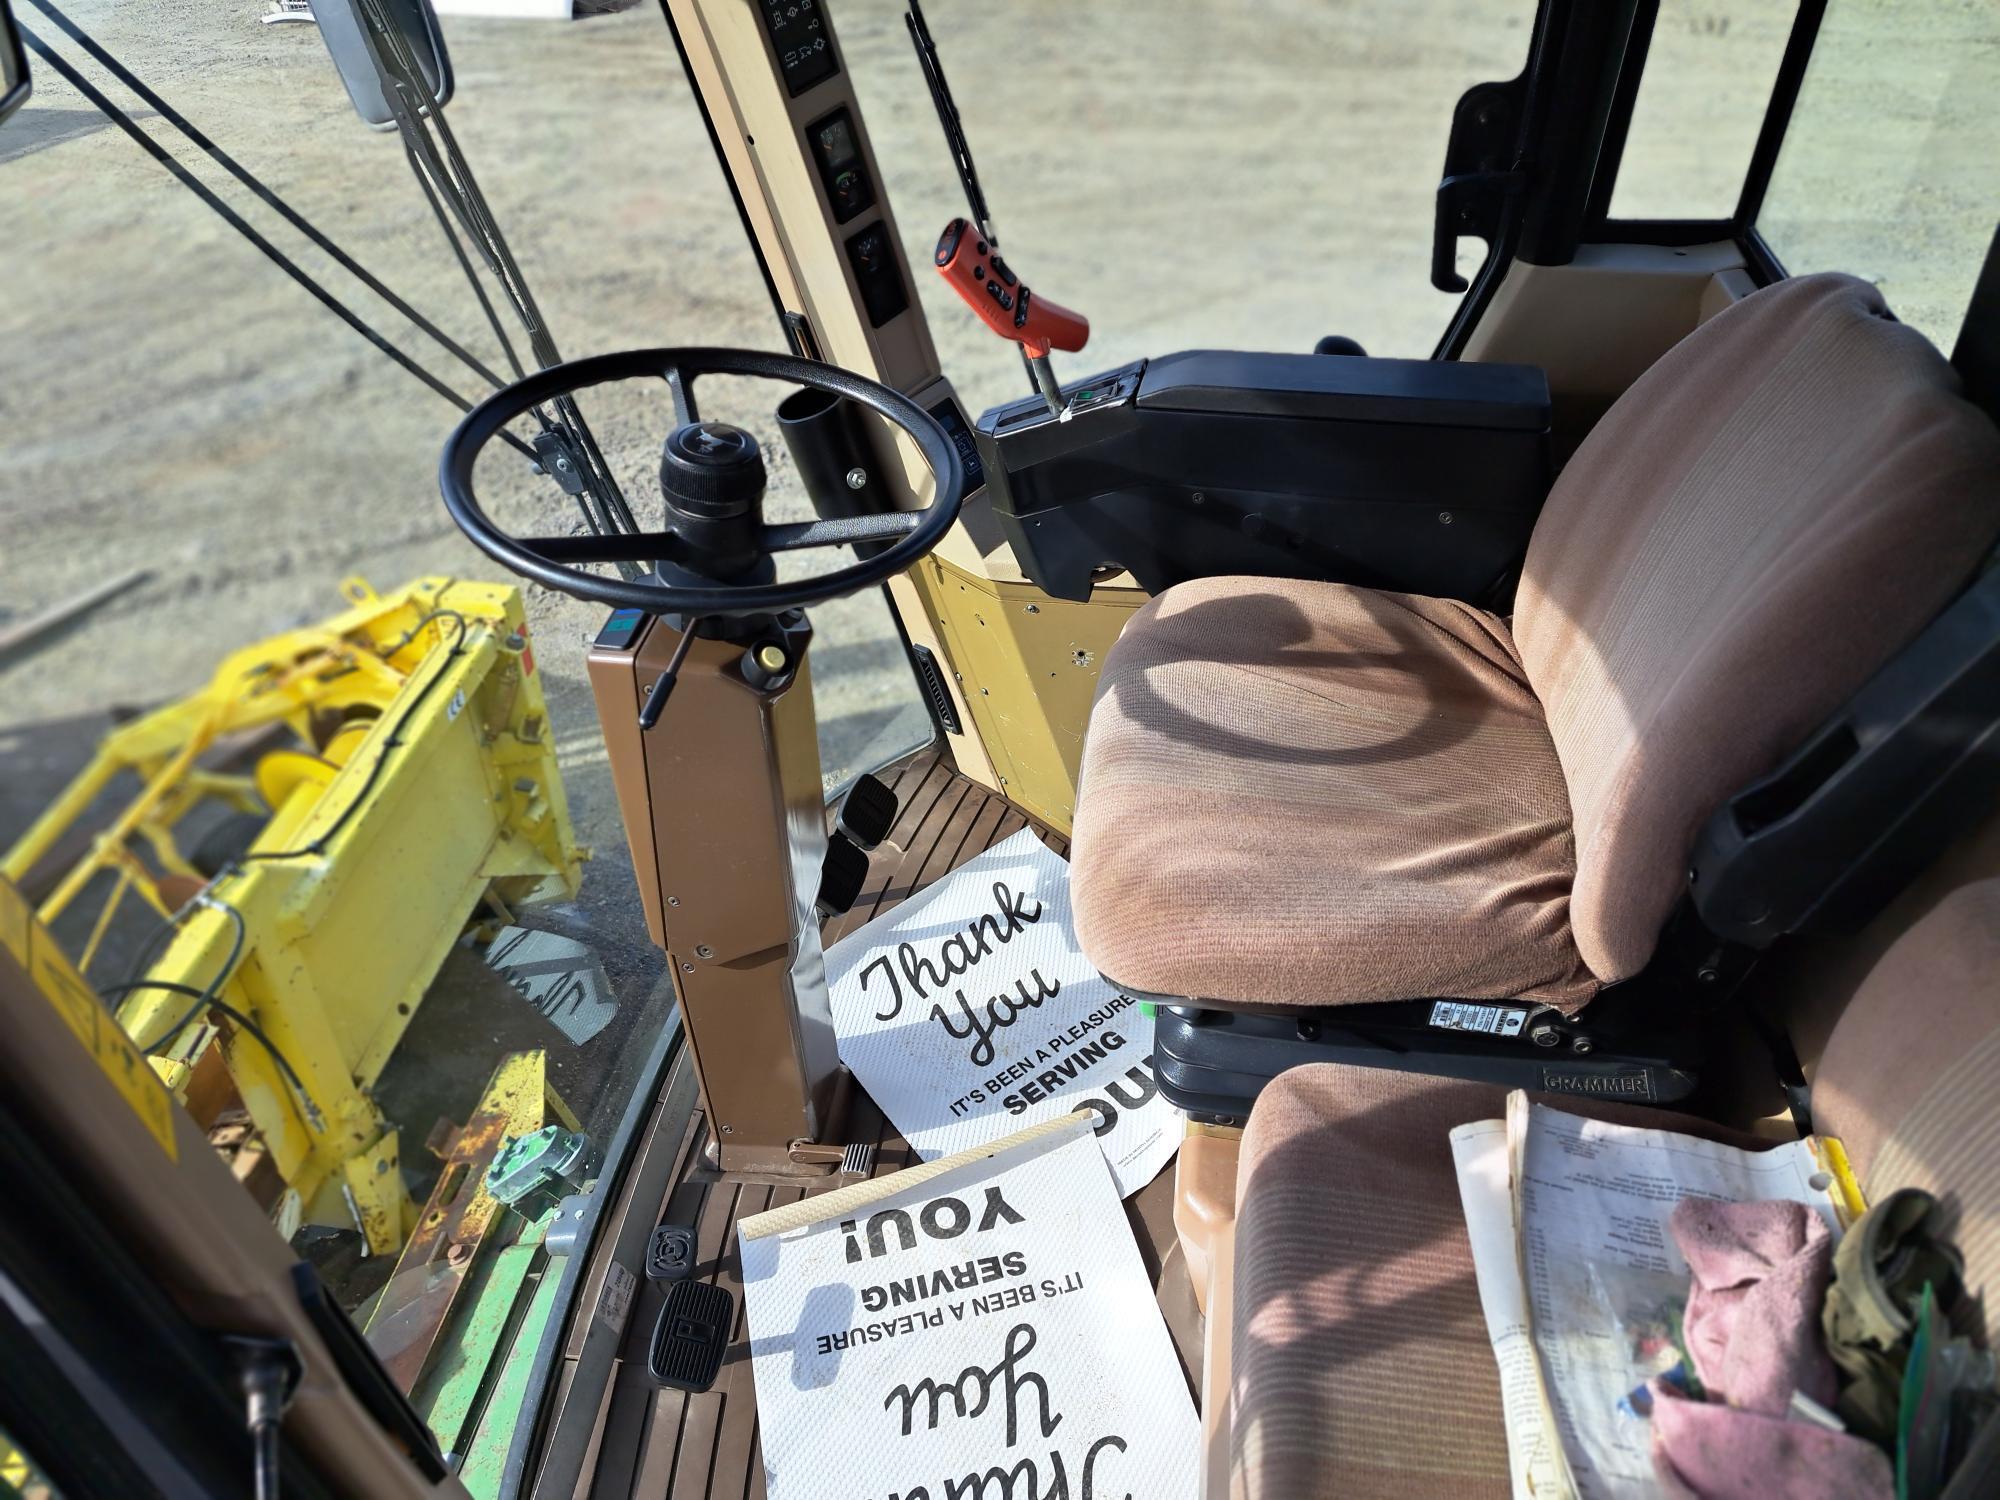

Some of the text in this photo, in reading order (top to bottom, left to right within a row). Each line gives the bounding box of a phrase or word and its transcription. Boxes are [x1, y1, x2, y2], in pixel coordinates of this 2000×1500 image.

[859, 881, 1042, 1022] Thank
[930, 968, 1060, 1067] You
[949, 994, 1136, 1117] IT'S BEEN A PLEASURE
[1003, 1031, 1127, 1115] SERVING
[1071, 1055, 1158, 1138] OU
[1544, 1075, 1648, 1095] GRAMMER
[840, 1186, 1026, 1263] YOU!
[815, 1271, 1084, 1356] IT'S BEEN A PLEASURE
[861, 1251, 1028, 1312] SERVING
[884, 1323, 1063, 1448] You
